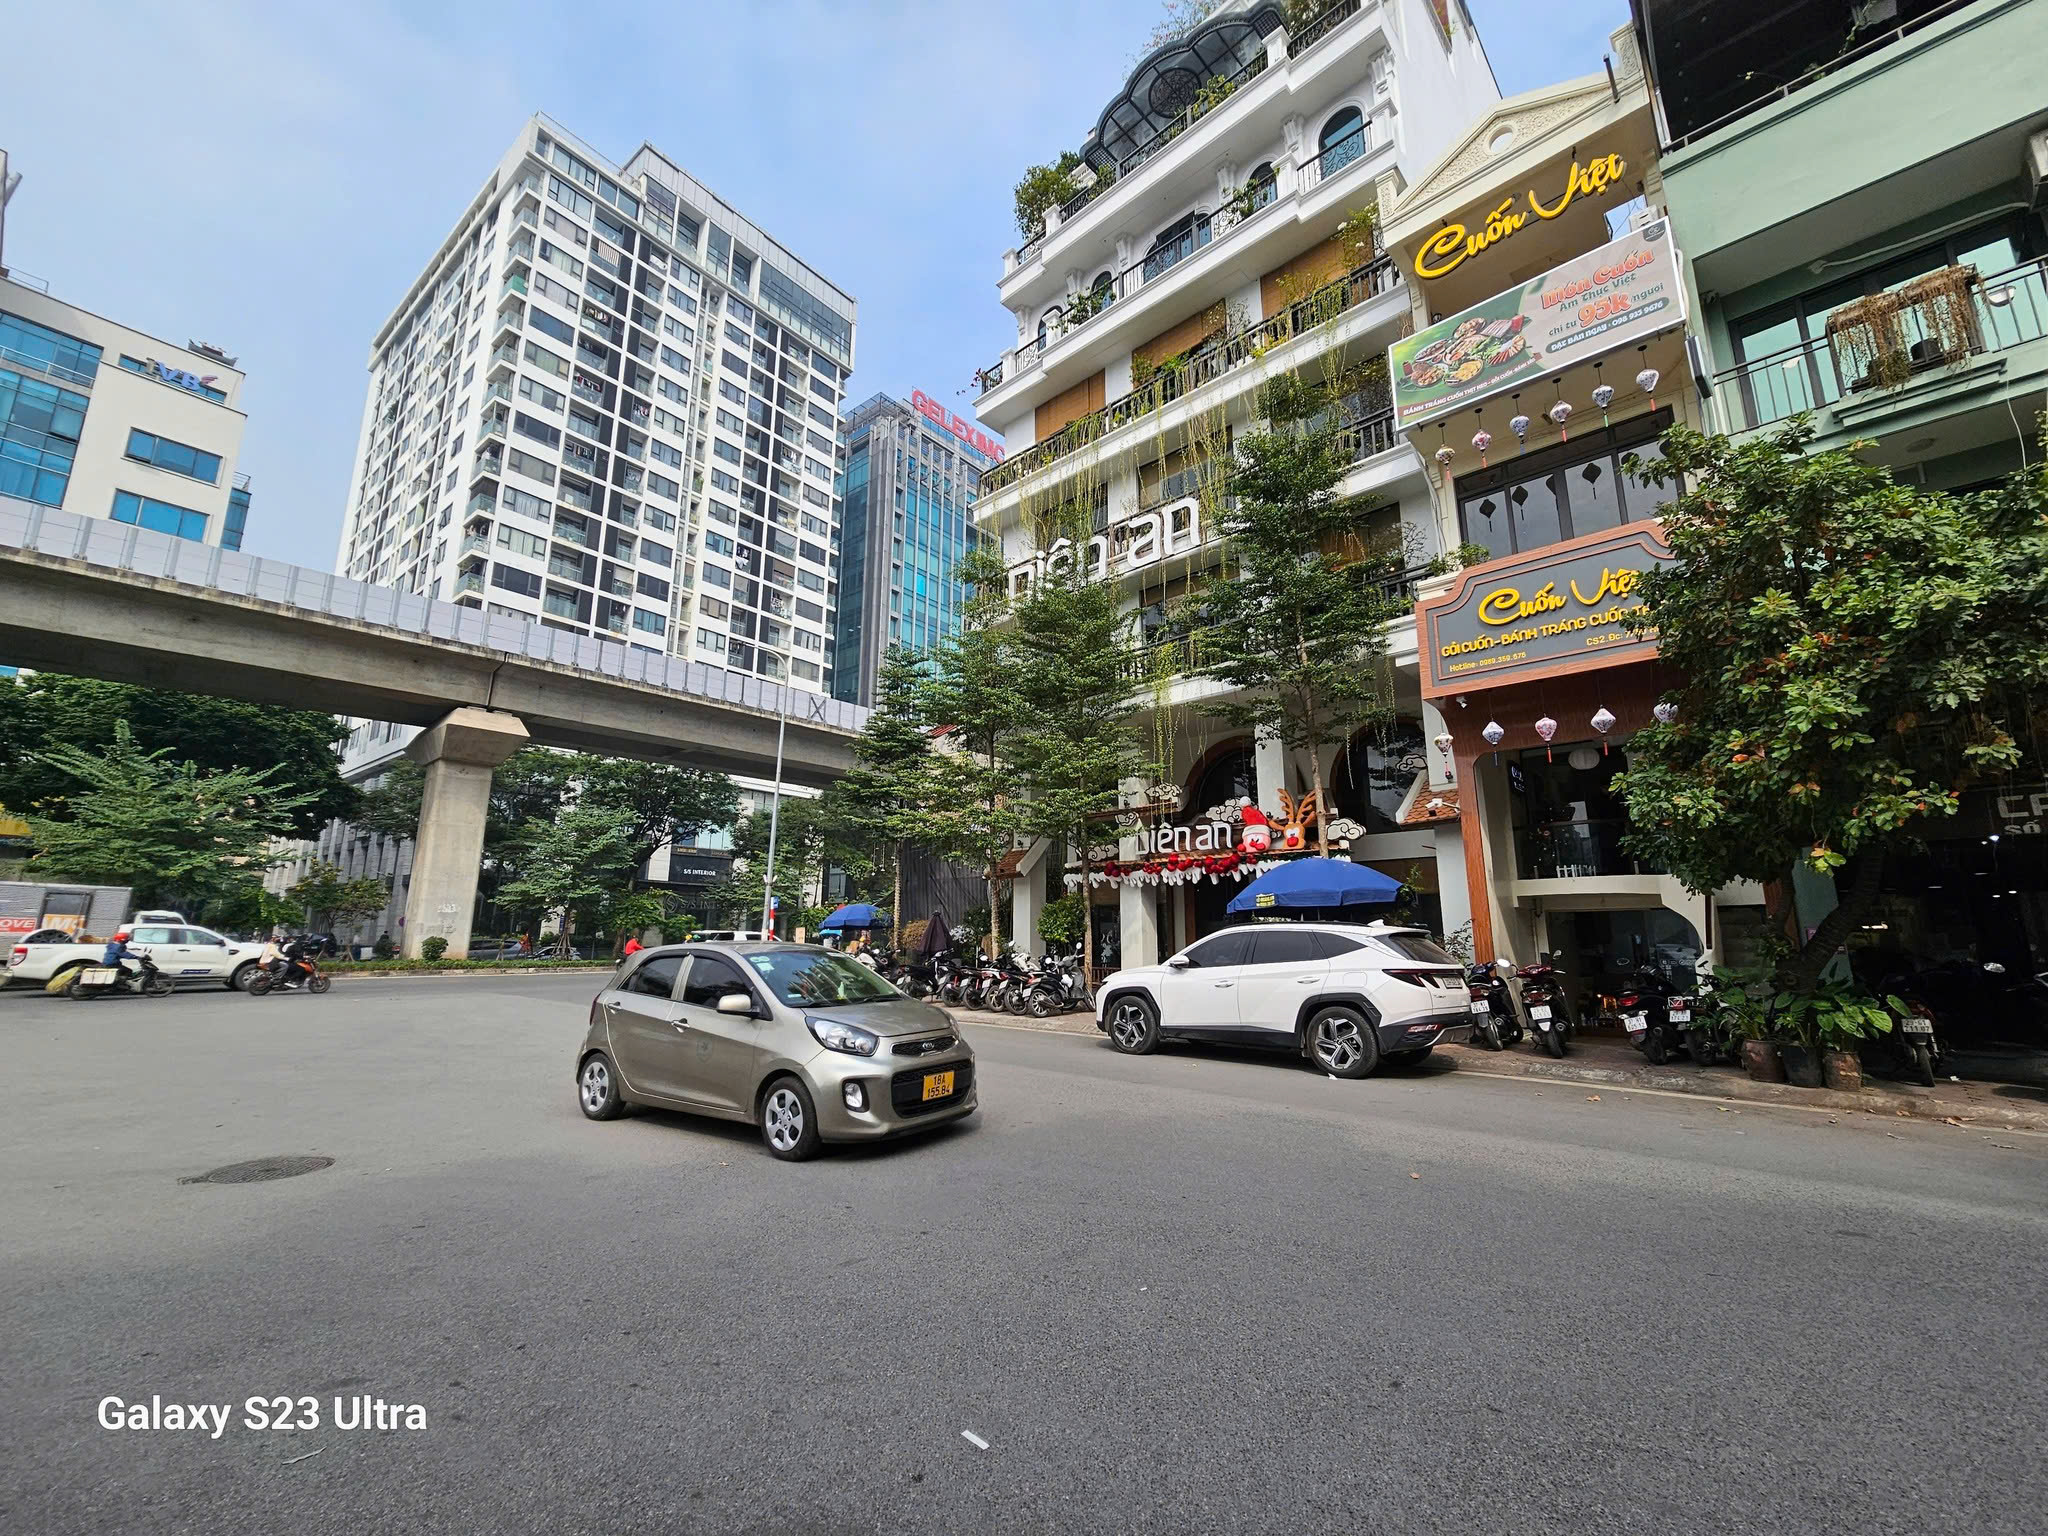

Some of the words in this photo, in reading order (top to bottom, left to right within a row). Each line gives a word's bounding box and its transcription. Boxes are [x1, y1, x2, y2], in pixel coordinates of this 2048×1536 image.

[1415, 197, 1528, 279] Cuốn
[1528, 152, 1625, 219] Việt
[1127, 497, 1201, 568] an
[1479, 581, 1567, 625] Cuốn
[1195, 821, 1232, 851] an
